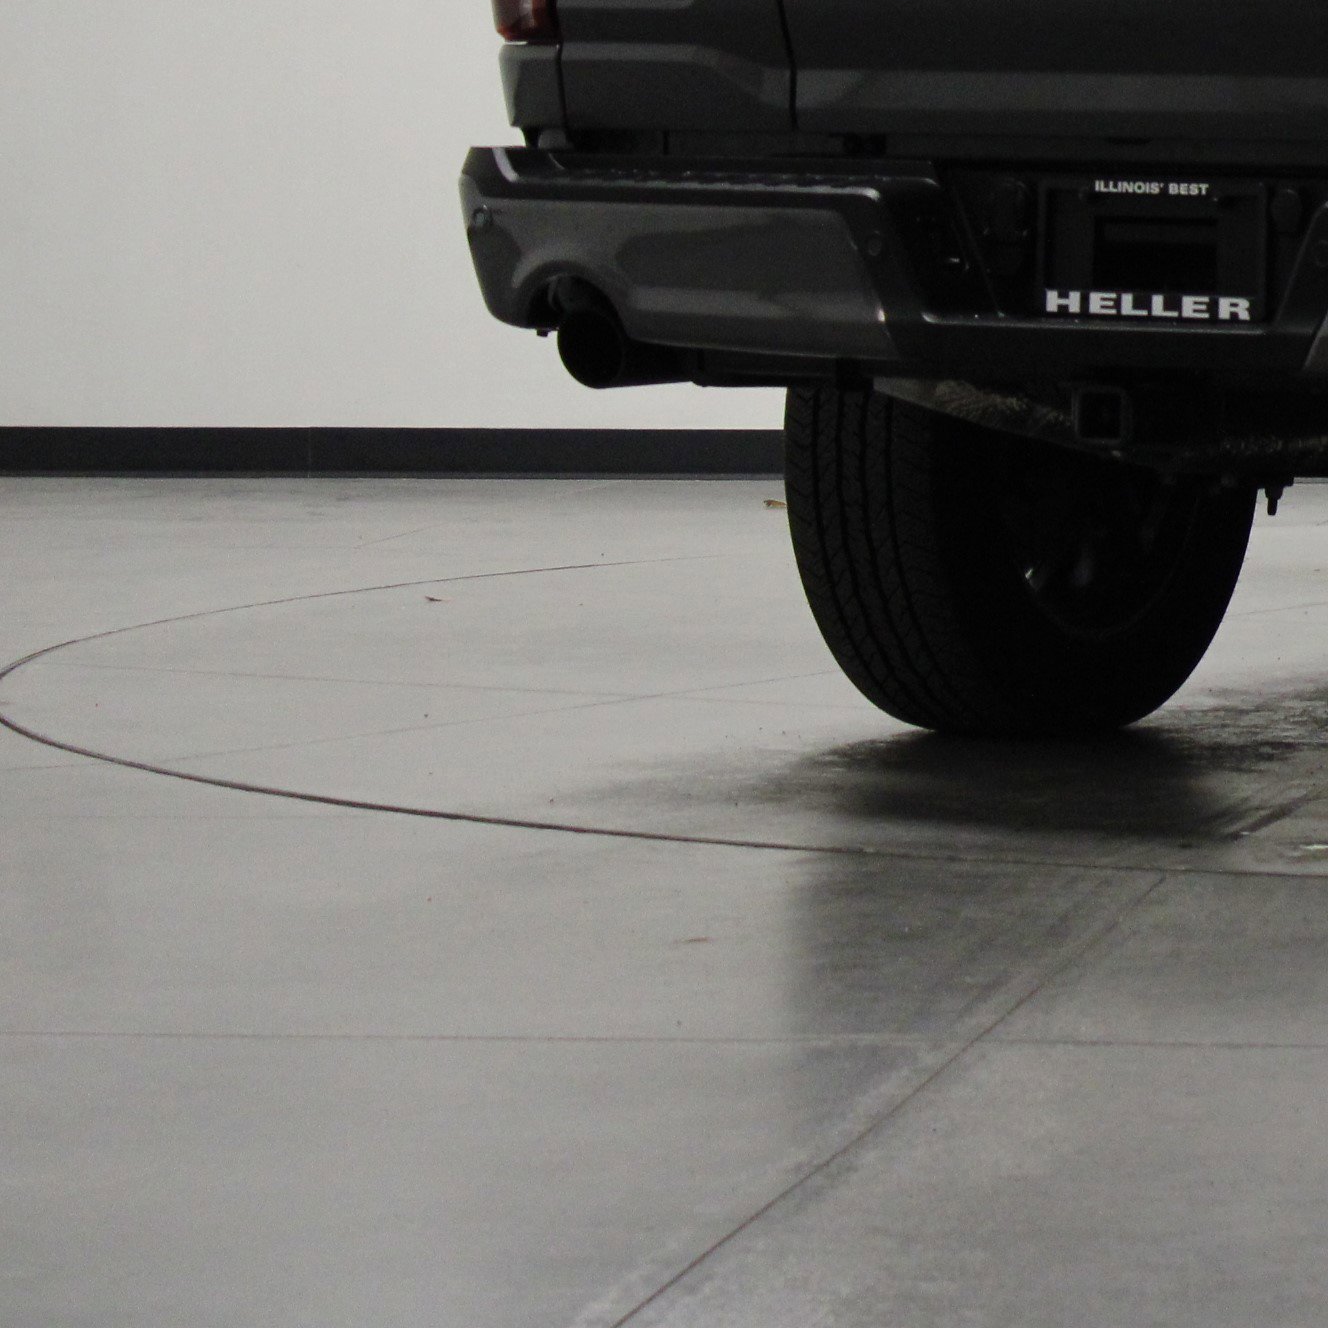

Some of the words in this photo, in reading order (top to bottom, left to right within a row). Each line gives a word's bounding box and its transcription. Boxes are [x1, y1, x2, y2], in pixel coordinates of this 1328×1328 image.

[1094, 179, 1165, 195] ILLINOIS'
[1168, 182, 1210, 196] BEST
[1045, 288, 1251, 321] HELLER
